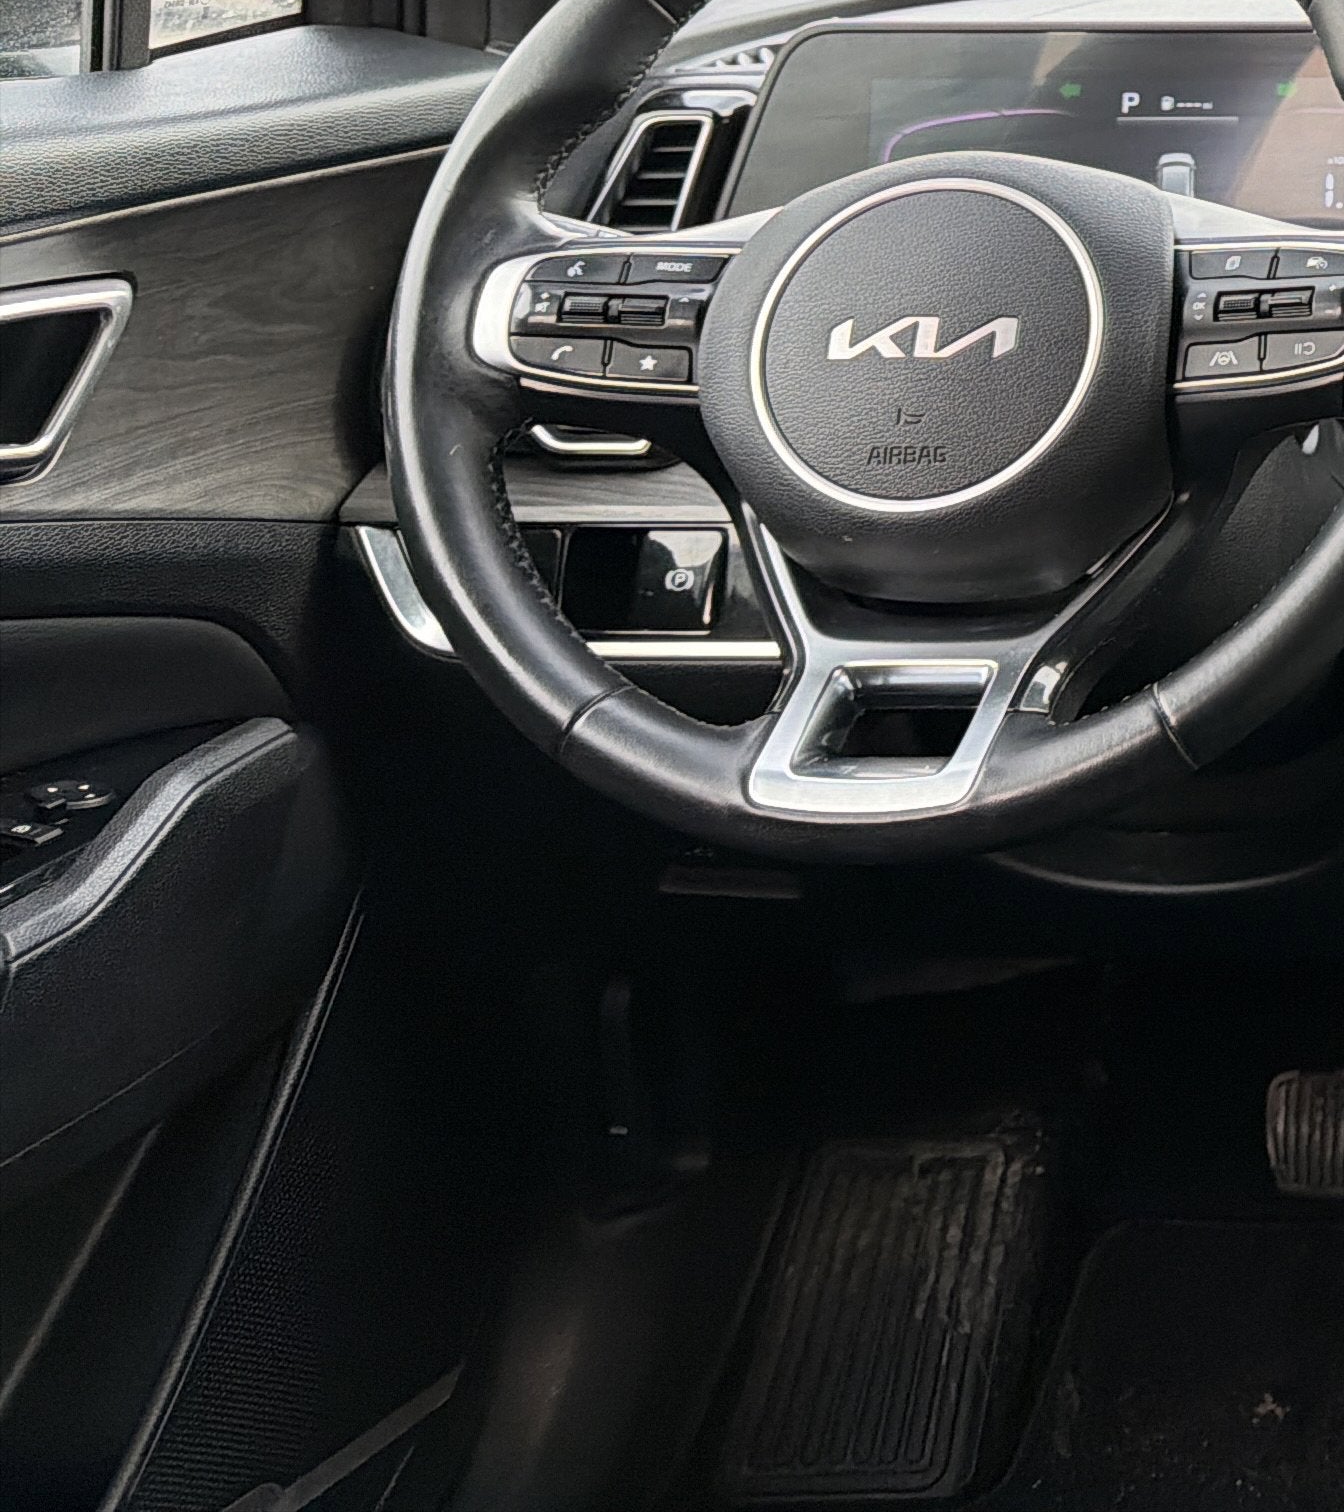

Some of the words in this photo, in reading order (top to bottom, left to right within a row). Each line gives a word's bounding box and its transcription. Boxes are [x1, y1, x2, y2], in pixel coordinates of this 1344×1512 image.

[1121, 92, 1140, 114] P
[655, 261, 693, 273] MODE
[1192, 301, 1206, 311] OK
[827, 316, 1019, 360] KIA
[866, 445, 947, 466] AIRBAG
